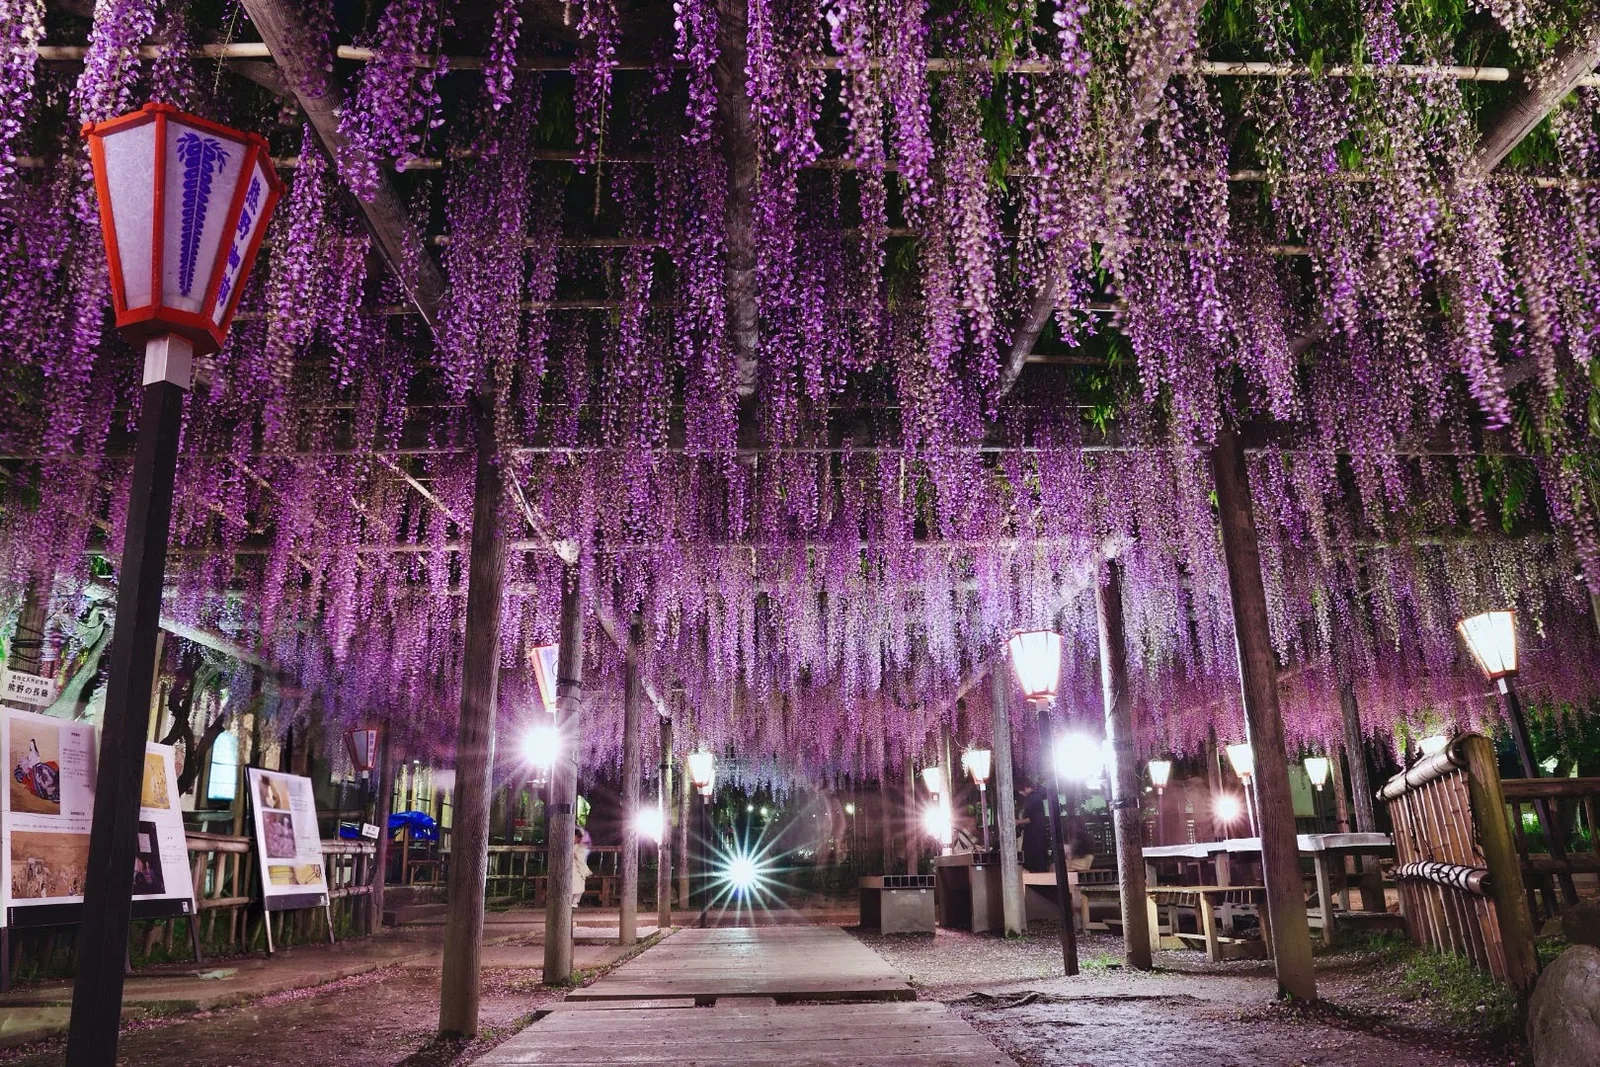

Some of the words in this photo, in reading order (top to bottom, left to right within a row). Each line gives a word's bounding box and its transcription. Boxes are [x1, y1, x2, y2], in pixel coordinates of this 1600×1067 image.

[8, 683, 48, 697] 熊野の長藤
